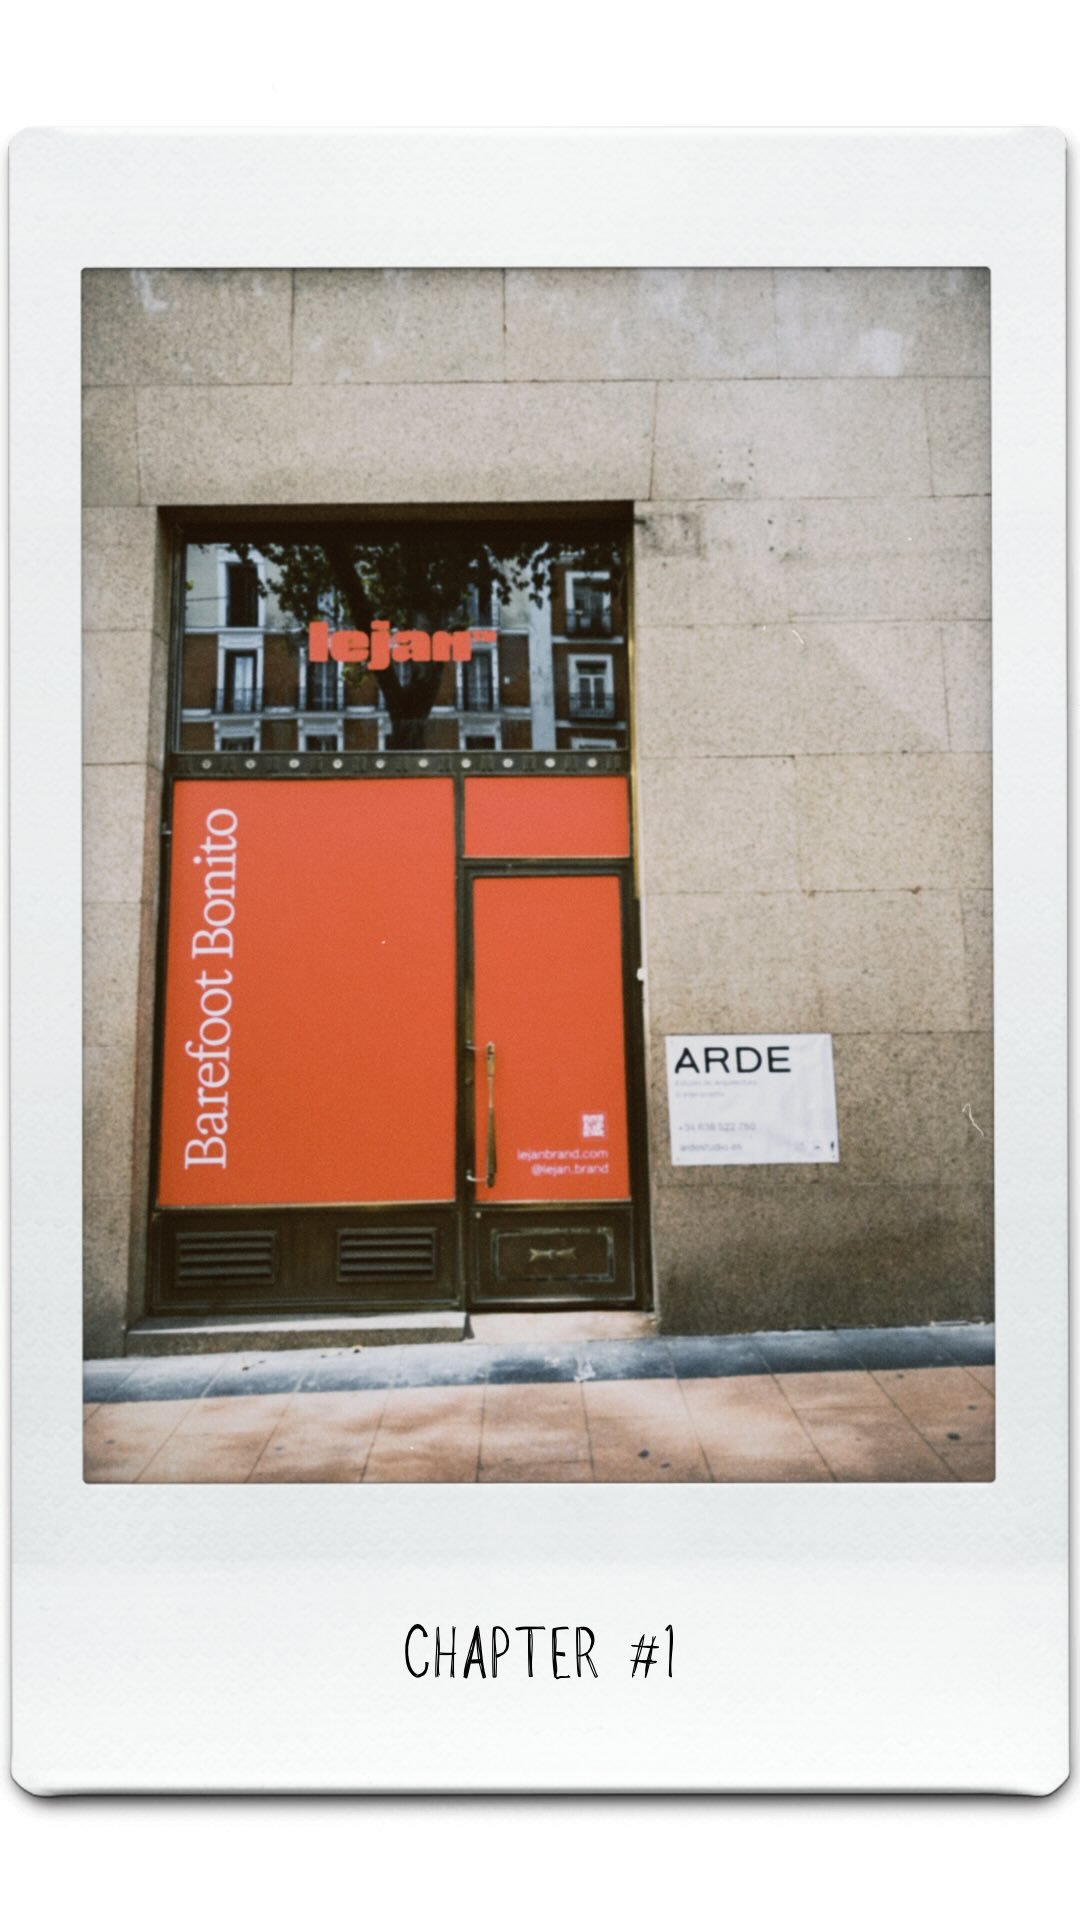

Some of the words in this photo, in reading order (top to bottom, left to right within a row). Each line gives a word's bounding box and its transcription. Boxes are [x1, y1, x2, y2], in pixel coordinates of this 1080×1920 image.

[191, 808, 238, 959] Bonito
[184, 969, 233, 1170] Barefoot
[674, 1046, 791, 1074] ARDE
[517, 1148, 609, 1162] lejanbrand.com
[531, 1162, 609, 1177] @lejan.brand
